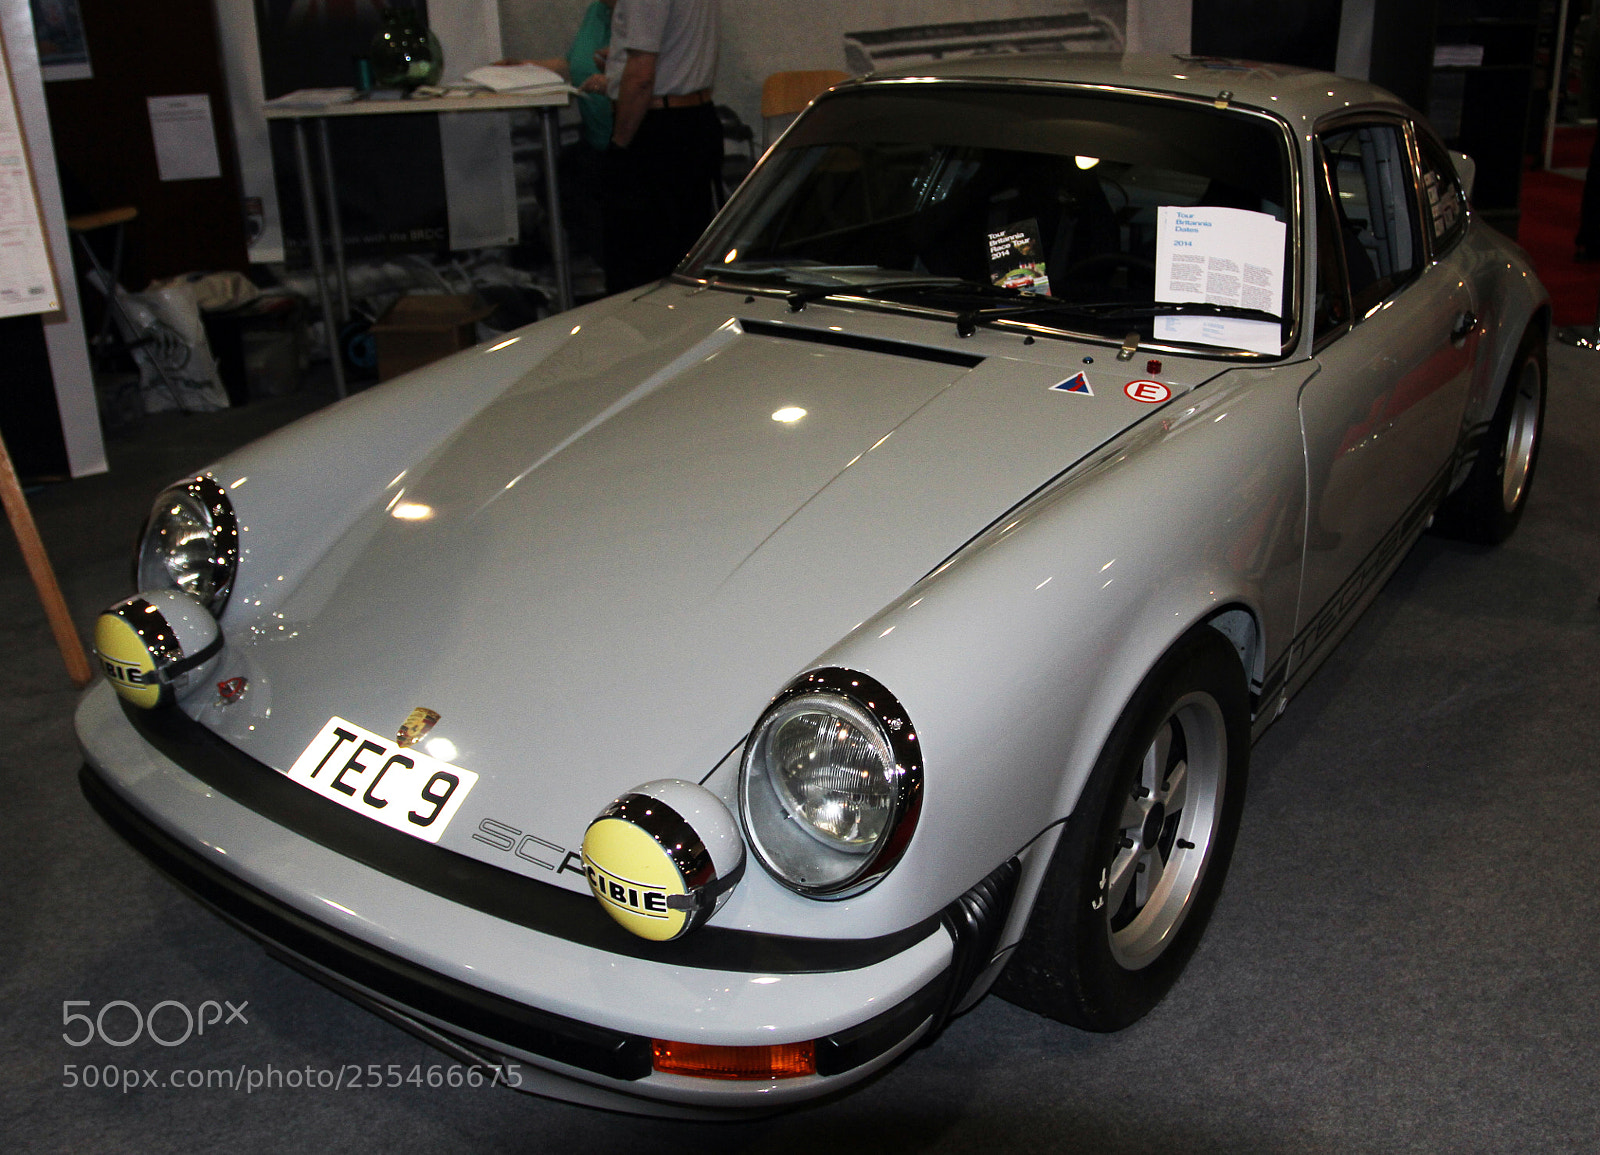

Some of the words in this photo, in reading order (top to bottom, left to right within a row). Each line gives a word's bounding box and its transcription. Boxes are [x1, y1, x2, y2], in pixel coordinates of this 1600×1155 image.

[1175, 219, 1212, 227] Britannia
[987, 230, 1005, 240] Tour
[988, 232, 1025, 246] Britannia
[990, 242, 1012, 254] Race
[1012, 237, 1031, 247] Tour
[990, 249, 1011, 261] 2014
[1134, 383, 1160, 400] E
[310, 726, 415, 809] TEC
[407, 771, 460, 828] 9
